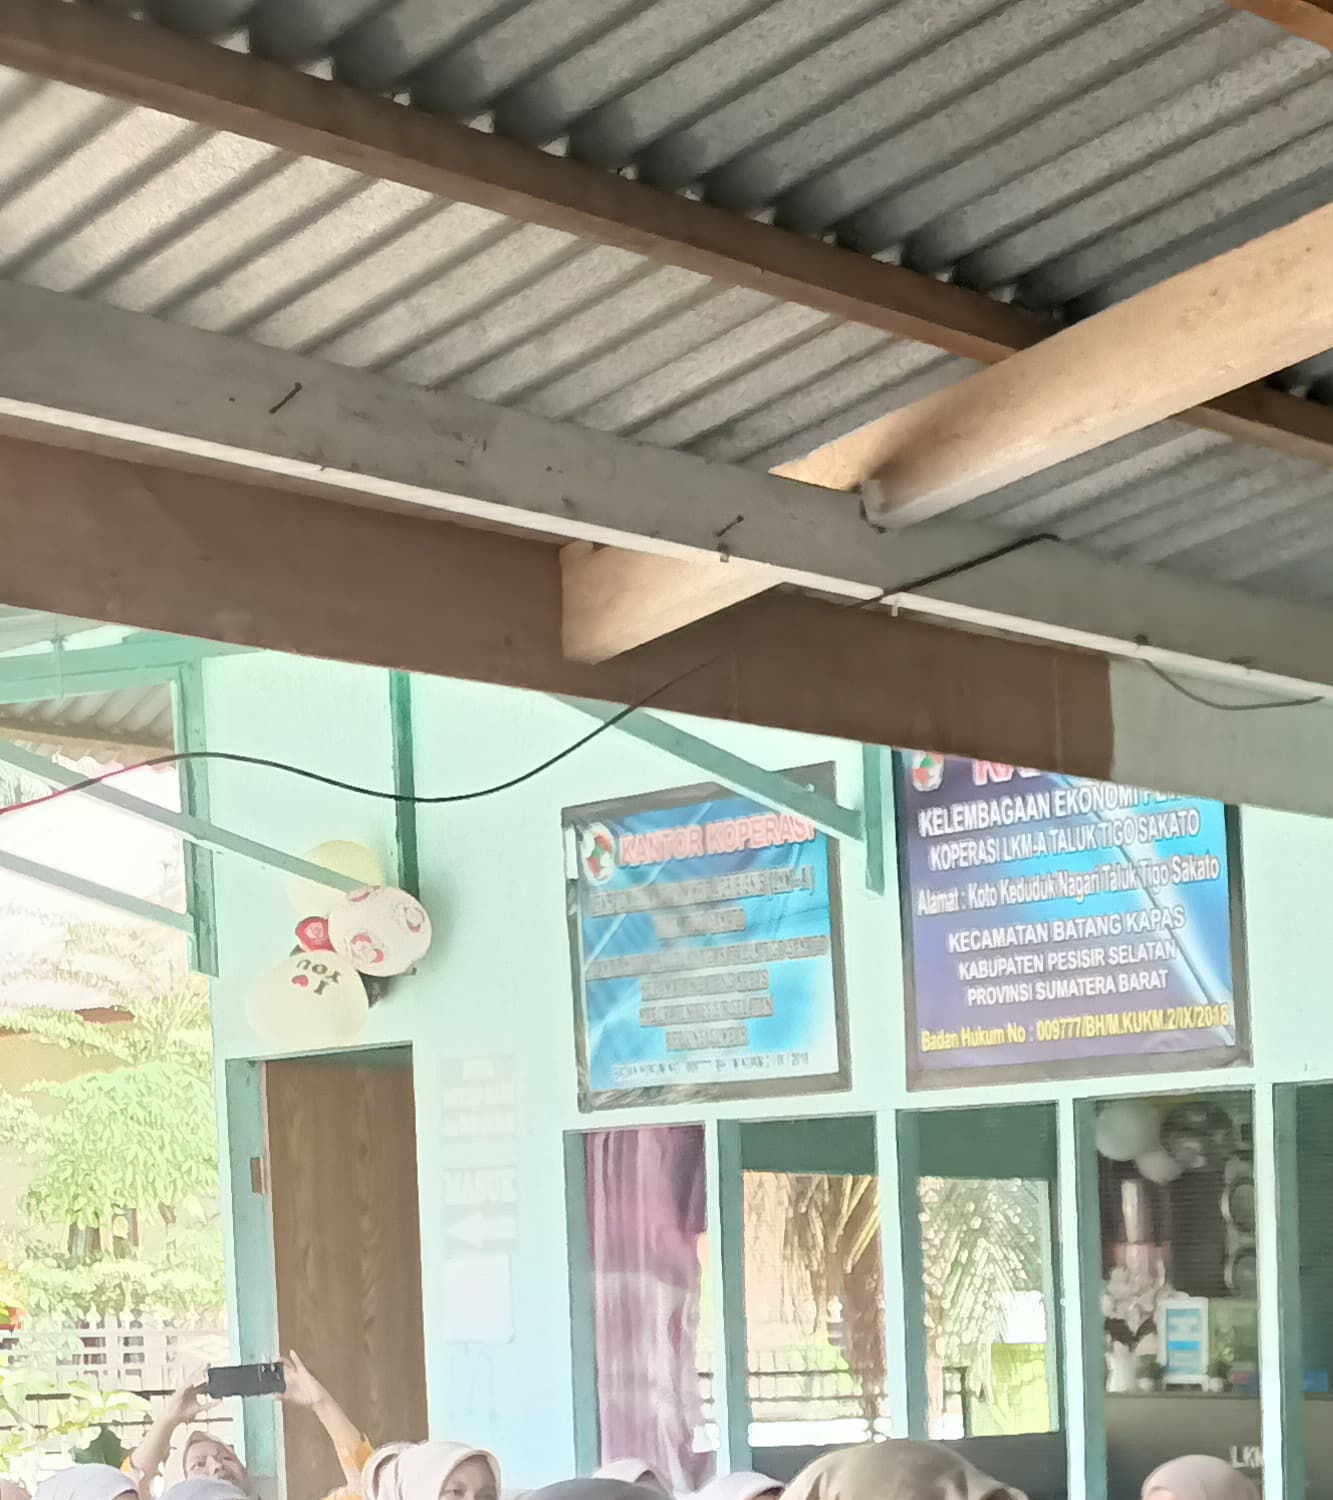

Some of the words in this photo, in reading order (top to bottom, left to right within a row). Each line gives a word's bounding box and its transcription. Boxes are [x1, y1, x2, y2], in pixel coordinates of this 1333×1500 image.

[919, 792, 1050, 838] KELEMBAGAAN
[1054, 785, 1139, 817] EKONOMI
[620, 825, 704, 866] KANTOR
[706, 813, 815, 853] KOPERASI
[929, 840, 1001, 872] KOPERASI
[1003, 832, 1048, 861] LKM-A
[1050, 826, 1097, 855] TALUK
[1099, 820, 1137, 848] TIGO
[1138, 810, 1200, 844] SAKATO
[917, 889, 959, 916] Alamat
[968, 883, 998, 909] Koto
[1000, 874, 1056, 905] Keduduk
[1058, 868, 1099, 902] Nagari
[1102, 863, 1136, 891] Taluk
[1139, 860, 1169, 894] Tigo
[1171, 852, 1220, 886] Sakato
[948, 924, 1049, 953] KECAMATAN
[1052, 914, 1121, 942] BATANG
[1125, 906, 1186, 932] KAPAS
[296, 960, 341, 984] YOU
[958, 955, 1044, 981] KABUPATEN
[1047, 947, 1106, 972] PESISIR
[1108, 940, 1178, 966] SELATAN
[314, 980, 330, 995] I
[967, 983, 1032, 1007] PROVINSI
[1036, 975, 1115, 1000] SUMATERA
[1119, 969, 1168, 993] BARAT
[921, 1028, 960, 1052] Badan
[961, 1025, 1005, 1048] Hukum
[1007, 1022, 1026, 1044] No
